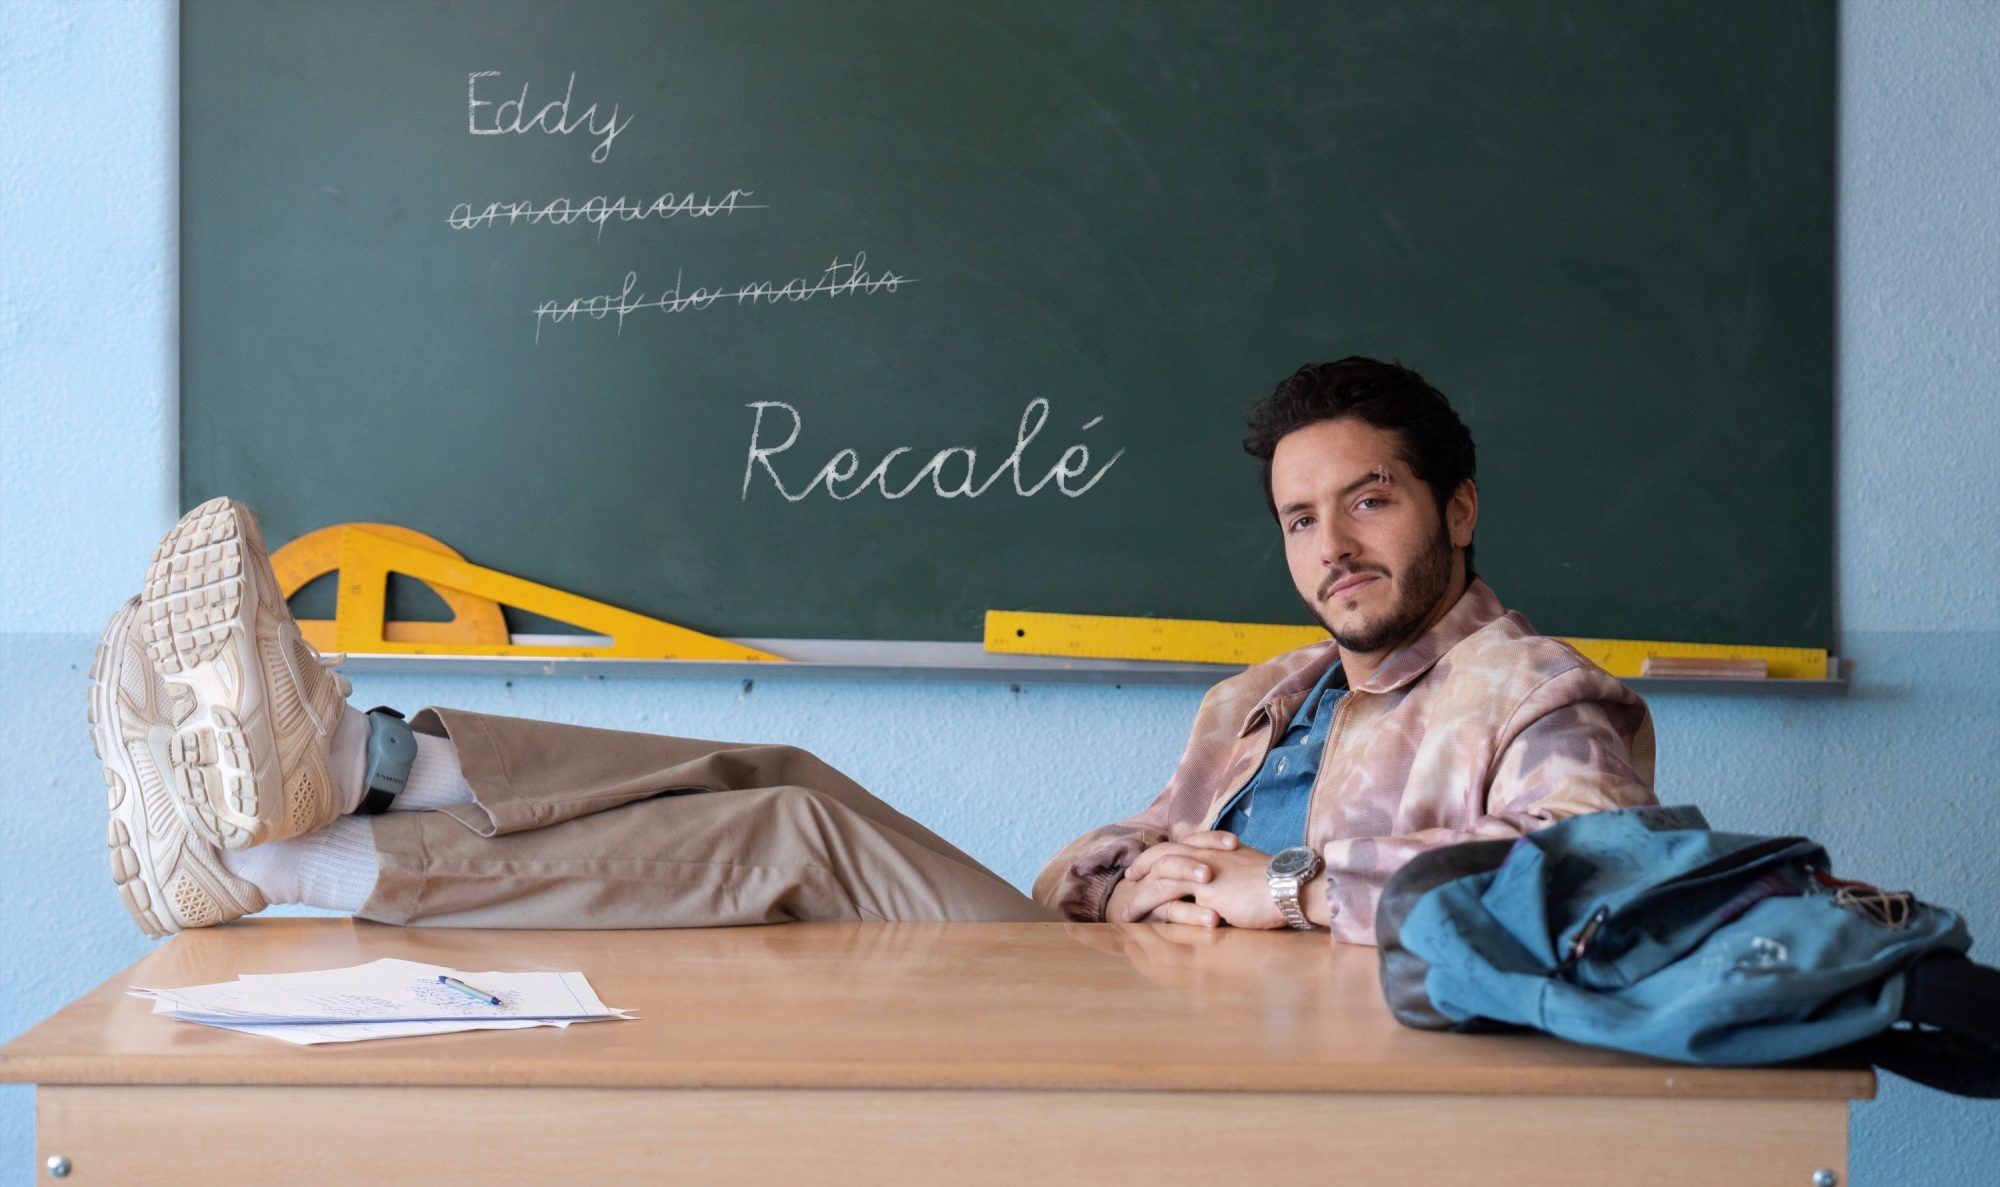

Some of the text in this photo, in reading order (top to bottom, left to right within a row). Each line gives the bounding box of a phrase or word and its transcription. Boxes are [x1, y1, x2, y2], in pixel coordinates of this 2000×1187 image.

[468, 70, 635, 164] Eddy
[447, 188, 756, 243] arnaqueur
[533, 250, 907, 346] prof de maths
[741, 396, 1127, 502] Recalé
